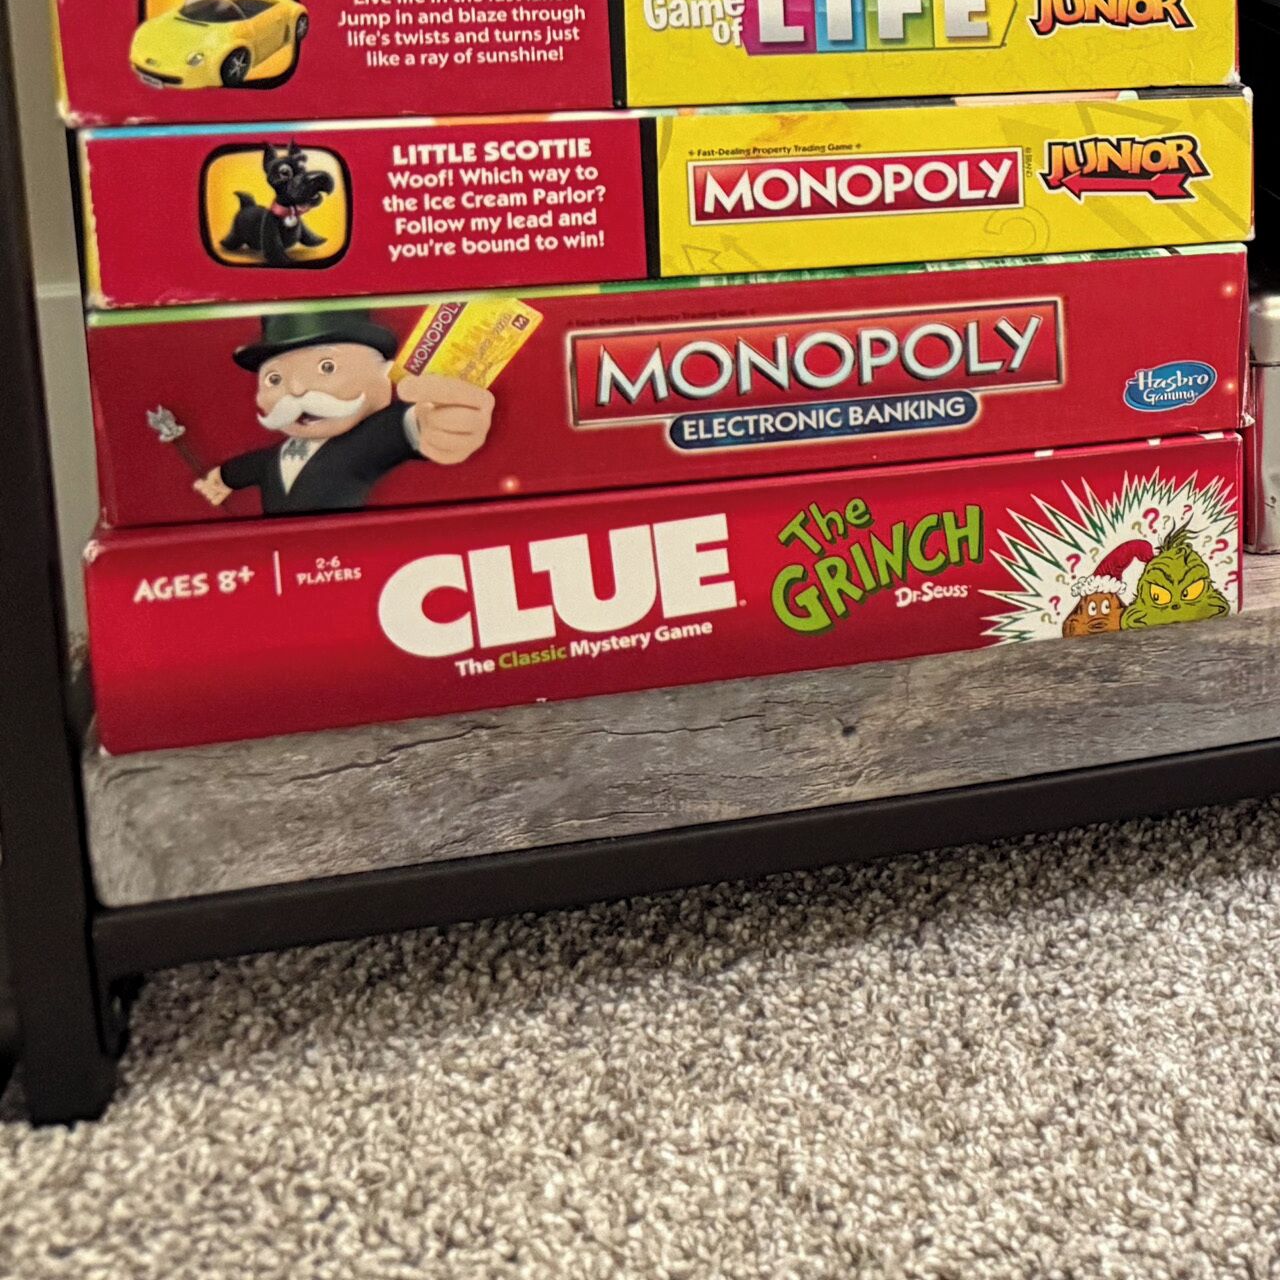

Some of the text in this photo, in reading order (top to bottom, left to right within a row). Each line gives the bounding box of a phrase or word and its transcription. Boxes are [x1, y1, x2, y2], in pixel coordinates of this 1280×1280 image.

[338, 4, 586, 29] Jump in and blaze through
[347, 25, 581, 47] life's twists and turns just
[711, 15, 744, 48] of
[366, 46, 564, 68] like a ray of sunshine!
[392, 138, 593, 166] LITTLE SCOTTIE
[697, 143, 853, 158] Fast-Dealing Property Trading Game
[1046, 135, 1200, 176] JUNIOR
[388, 165, 599, 189] Woof! Which way to
[703, 157, 1014, 214] MONOPOLY
[382, 185, 606, 213] the Ice Cream Parlor?
[395, 207, 597, 235] Follow my lead and
[389, 230, 605, 263] you're bound to win!
[596, 315, 1044, 409] MONOPOLY
[1137, 364, 1209, 393] Hasbro
[1143, 384, 1196, 405] Gaming
[682, 396, 966, 442] ELECTRONIC BANKING
[778, 497, 872, 558] The
[296, 566, 362, 587] PLAYERS
[315, 556, 342, 569] 2-6
[771, 504, 984, 634] GRINCH
[132, 565, 256, 603] AGES 8+
[378, 513, 738, 658] CLUE
[455, 621, 713, 677] The Classic Mystery Game
